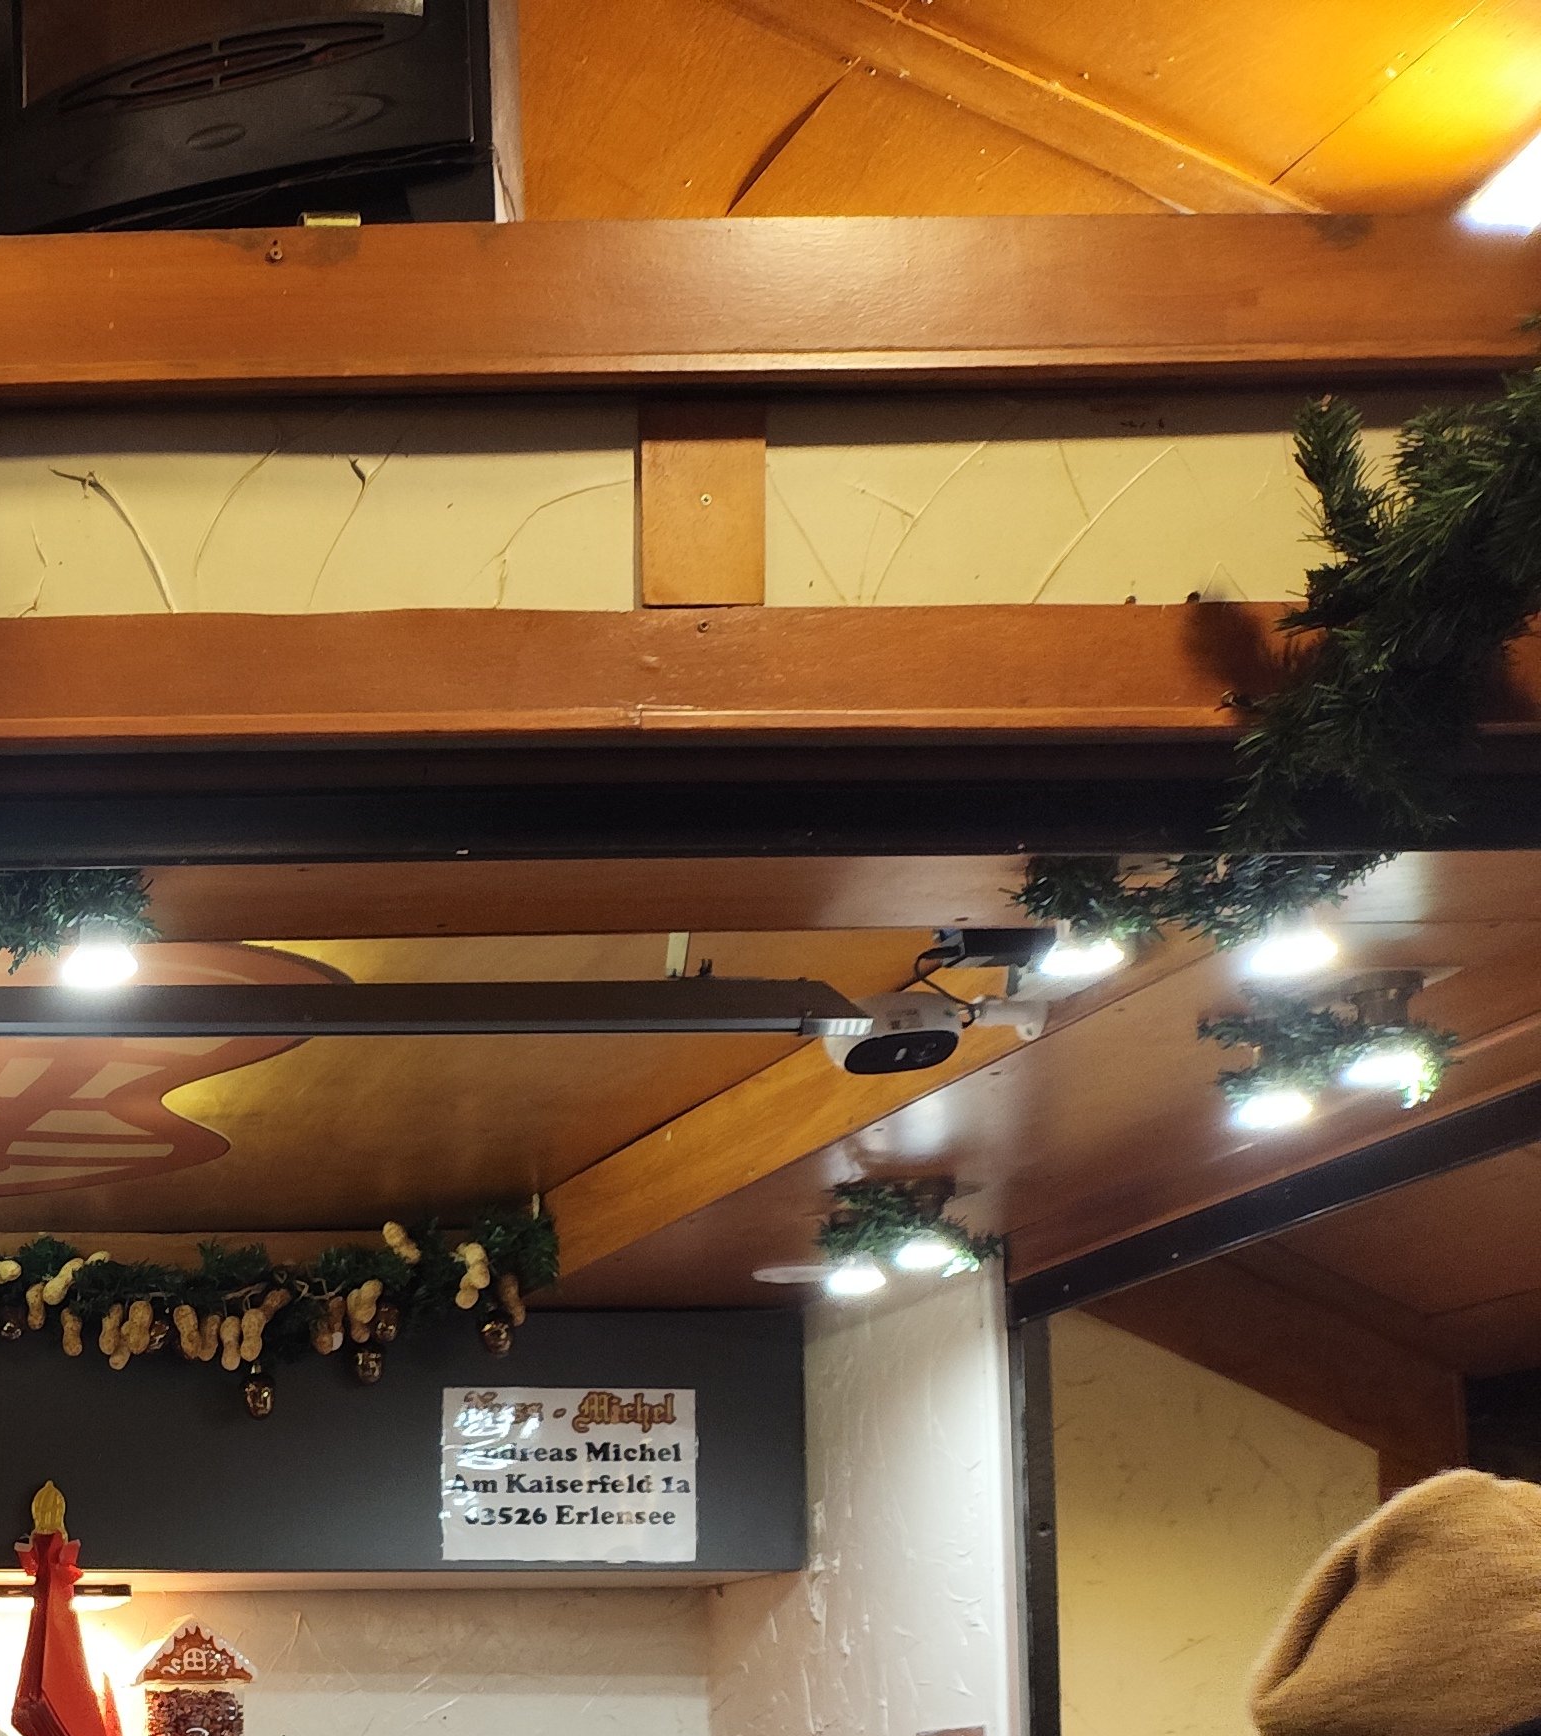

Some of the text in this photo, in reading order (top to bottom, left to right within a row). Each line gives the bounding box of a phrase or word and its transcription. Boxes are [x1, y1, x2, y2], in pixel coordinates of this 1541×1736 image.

[586, 1442, 681, 1462] Michel
[451, 1474, 690, 1494] Am Kaiserfeld 1a
[556, 1505, 675, 1524] Erlensee
